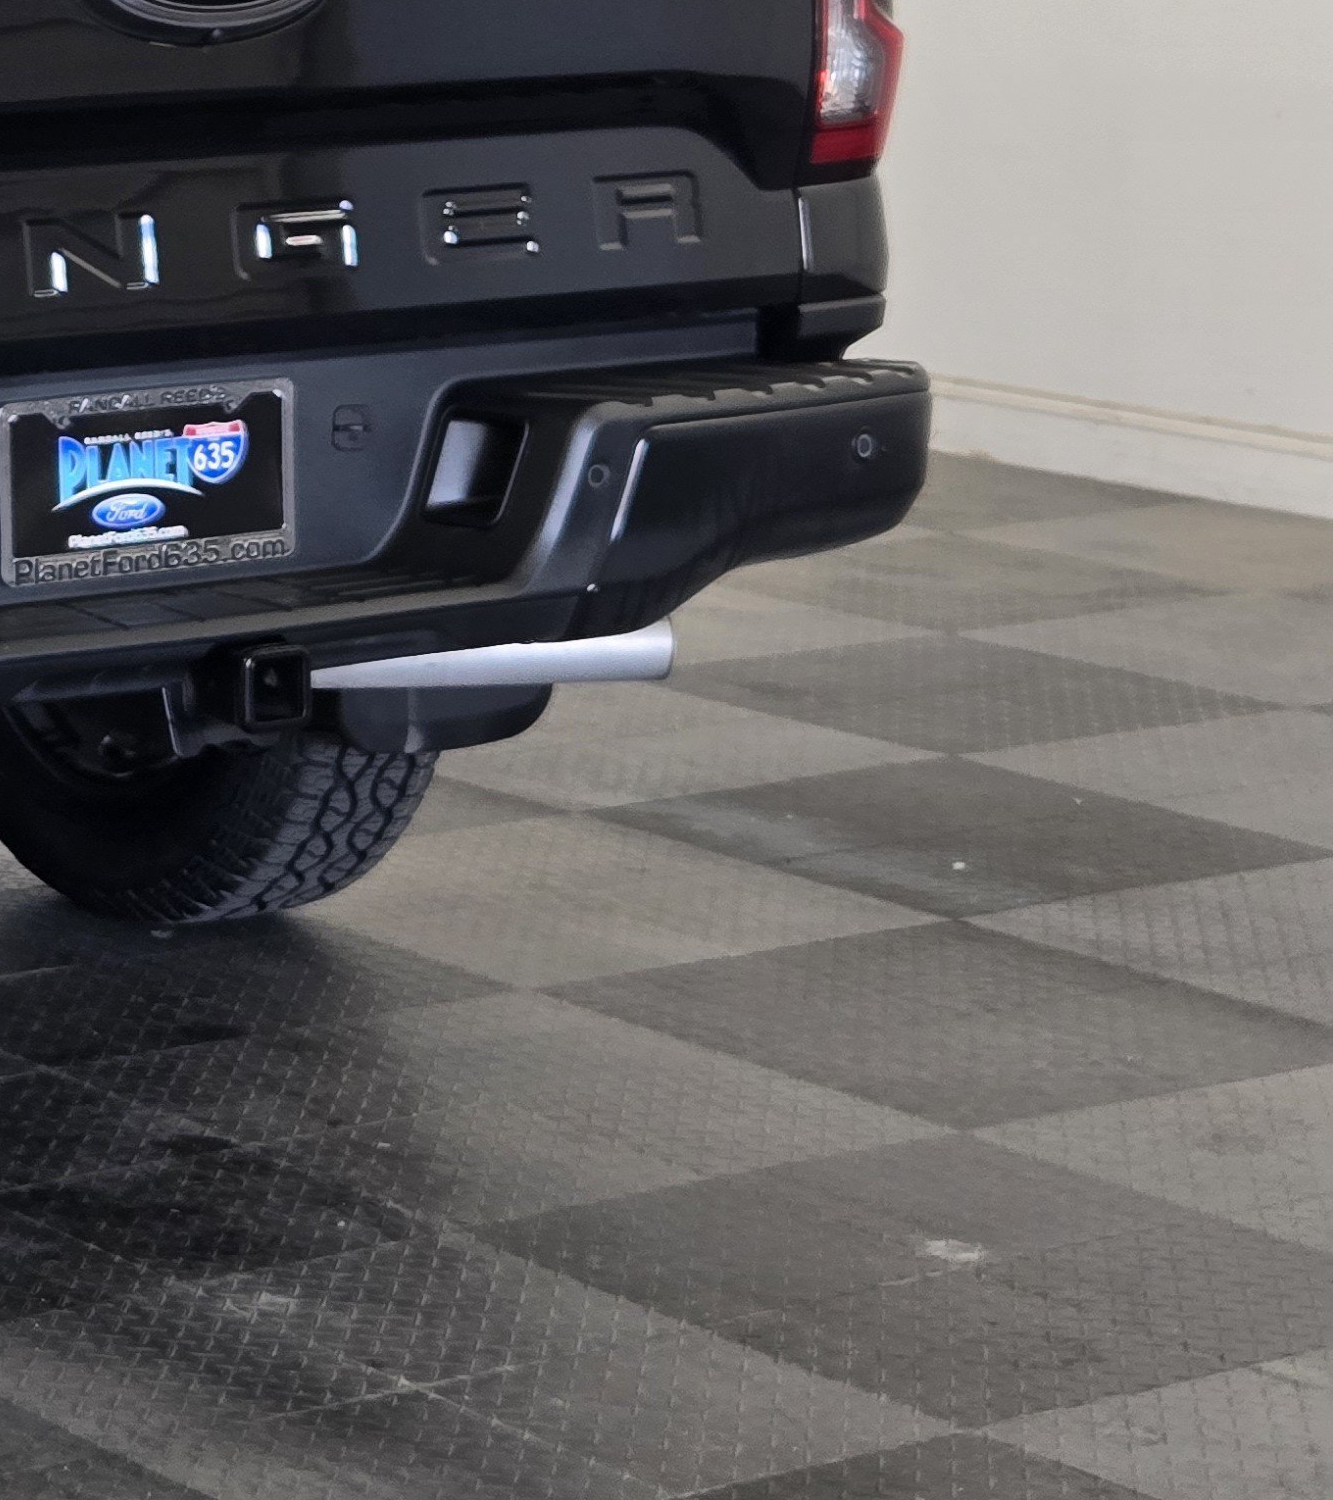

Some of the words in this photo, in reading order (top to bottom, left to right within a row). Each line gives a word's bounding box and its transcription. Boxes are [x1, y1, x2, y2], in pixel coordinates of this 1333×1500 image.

[58, 436, 194, 503] PLANET
[193, 441, 235, 471] 635
[106, 503, 148, 522] Ford
[15, 538, 286, 585] PlanetFord635.com
